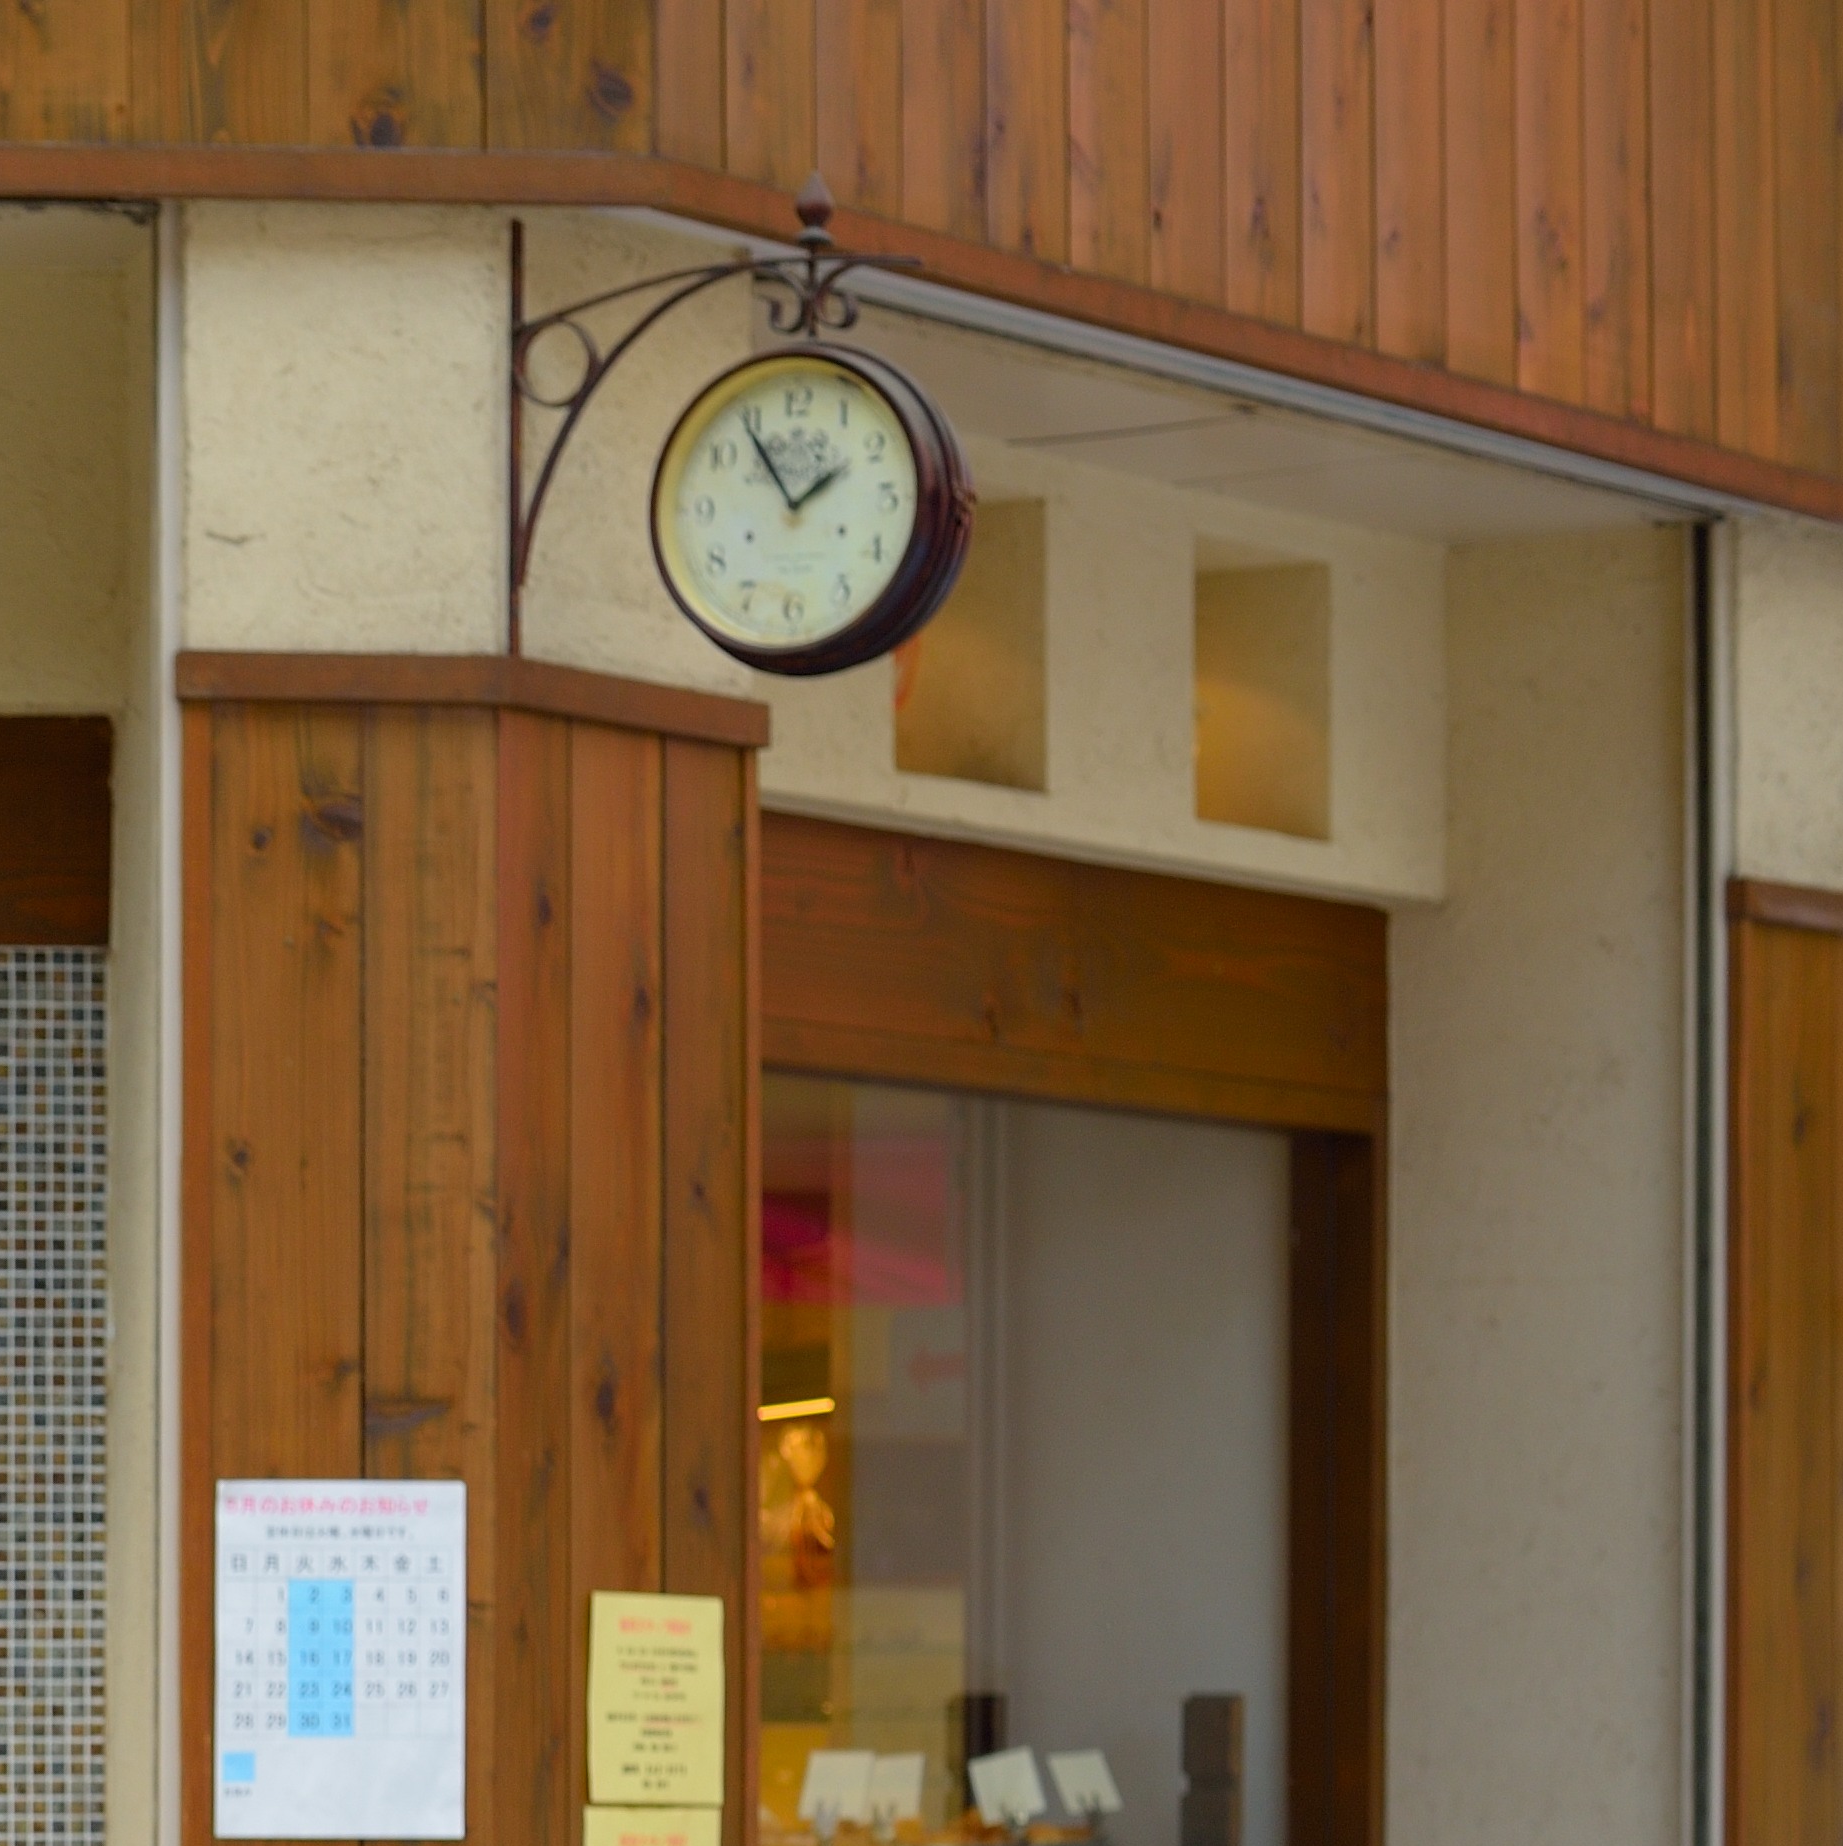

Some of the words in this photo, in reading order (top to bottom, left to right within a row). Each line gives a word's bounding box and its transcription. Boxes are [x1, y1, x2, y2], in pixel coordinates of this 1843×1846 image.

[233, 1555, 246, 1574] 日
[264, 1555, 279, 1574] 月
[296, 1555, 313, 1574] 火
[363, 1555, 379, 1574] 木
[427, 1555, 442, 1574] 土
